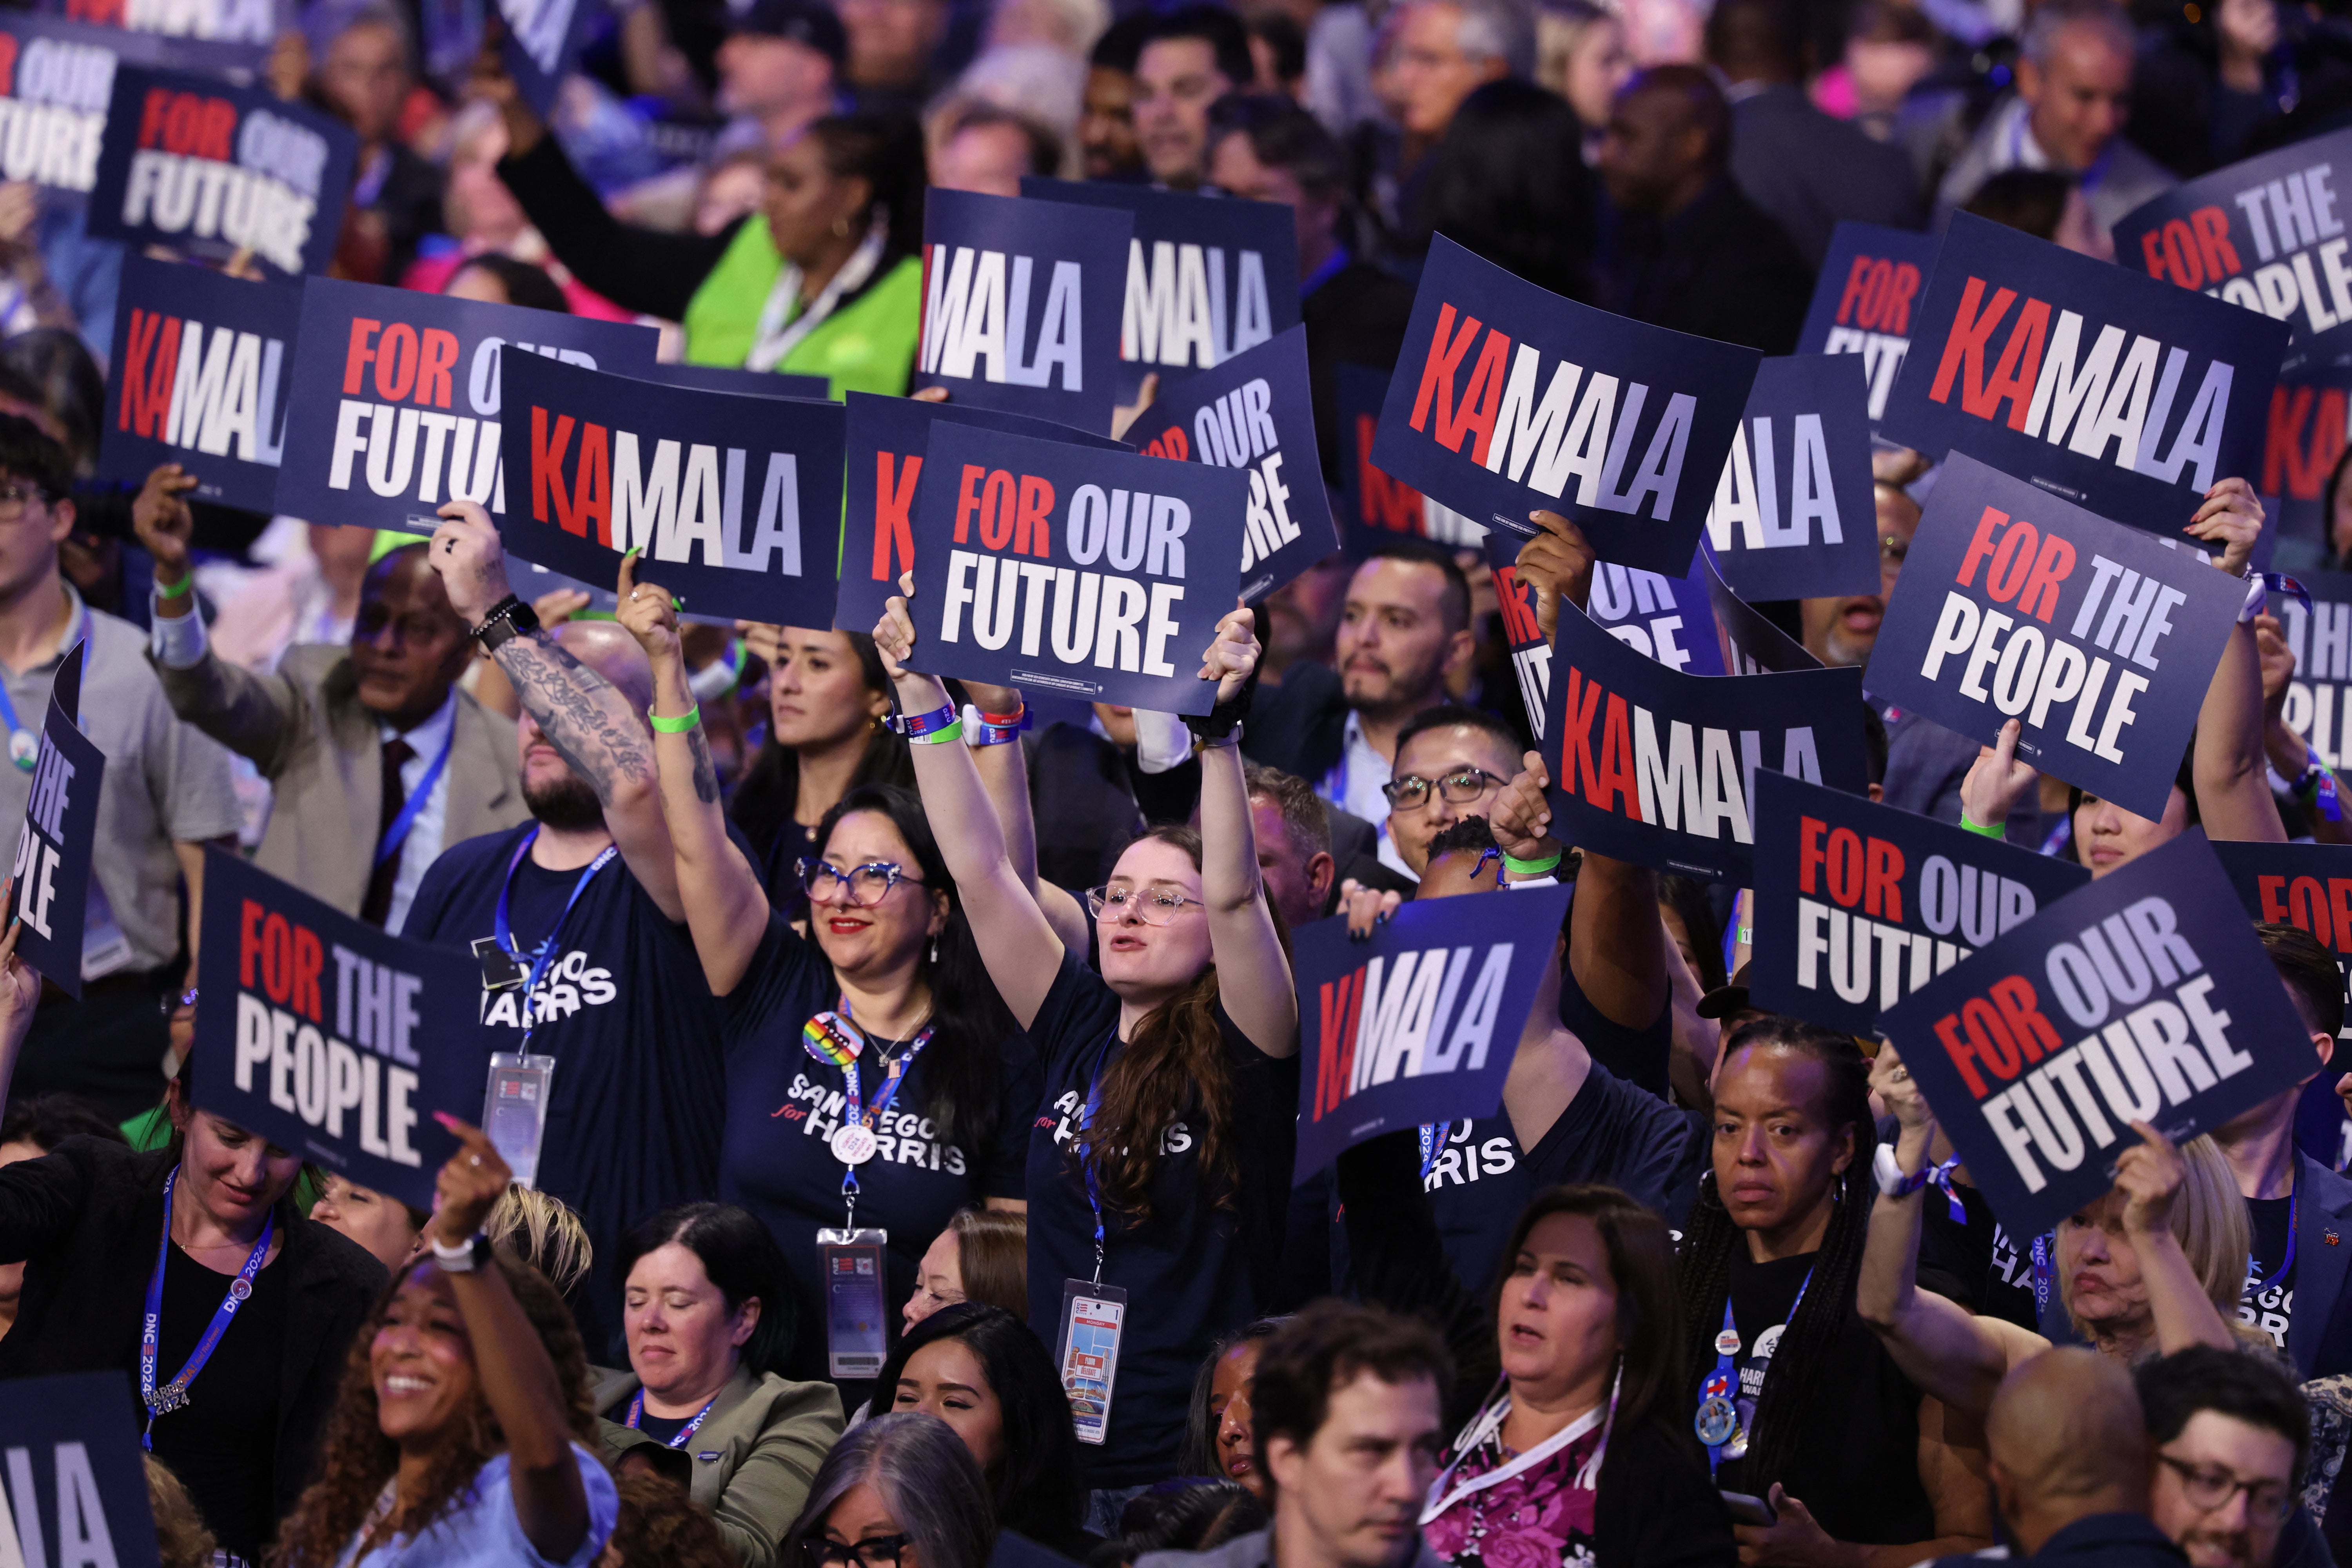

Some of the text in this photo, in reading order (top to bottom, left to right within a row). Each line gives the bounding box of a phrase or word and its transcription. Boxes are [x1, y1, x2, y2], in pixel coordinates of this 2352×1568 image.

[136, 87, 237, 163] FOR
[122, 149, 316, 275] FUTURE
[2141, 163, 2344, 292] FOR THE
[1836, 256, 1920, 335] FOR
[118, 308, 289, 467] KAMAL
[342, 317, 460, 408] FOR
[1194, 377, 1279, 468] OUR
[1409, 301, 1697, 522] KAMALA
[1929, 276, 2234, 495] KAMALA
[531, 405, 802, 577] KAMALA
[953, 464, 1055, 559] FOR
[1066, 484, 1191, 578] OUR
[941, 549, 1185, 678] FUTURE
[1956, 505, 2187, 671] FOR THE
[1920, 590, 2150, 765] PEOPLE
[591, 846, 618, 871] DNC
[1800, 815, 2036, 947] FOR OUR
[240, 898, 423, 1068] FOR THE
[2046, 896, 2202, 1029] OUR
[235, 991, 423, 1168] PEOPLE
[845, 1071, 858, 1096] DNC
[1313, 942, 1514, 1123] KAMALA
[1933, 975, 2063, 1099] FOR
[1980, 974, 2254, 1194] FUTURE
[771, 1103, 807, 1121] for
[803, 1108, 967, 1176] HRRIS
[787, 1073, 847, 1117] SAN
[1421, 1127, 1431, 1163] 2024
[163, 1171, 175, 1195] 024
[245, 1245, 265, 1278] 2024
[2034, 1236, 2048, 1313] DNC 2024
[142, 1313, 157, 1393] DNC 2024
[156, 1392, 190, 1416] 2024
